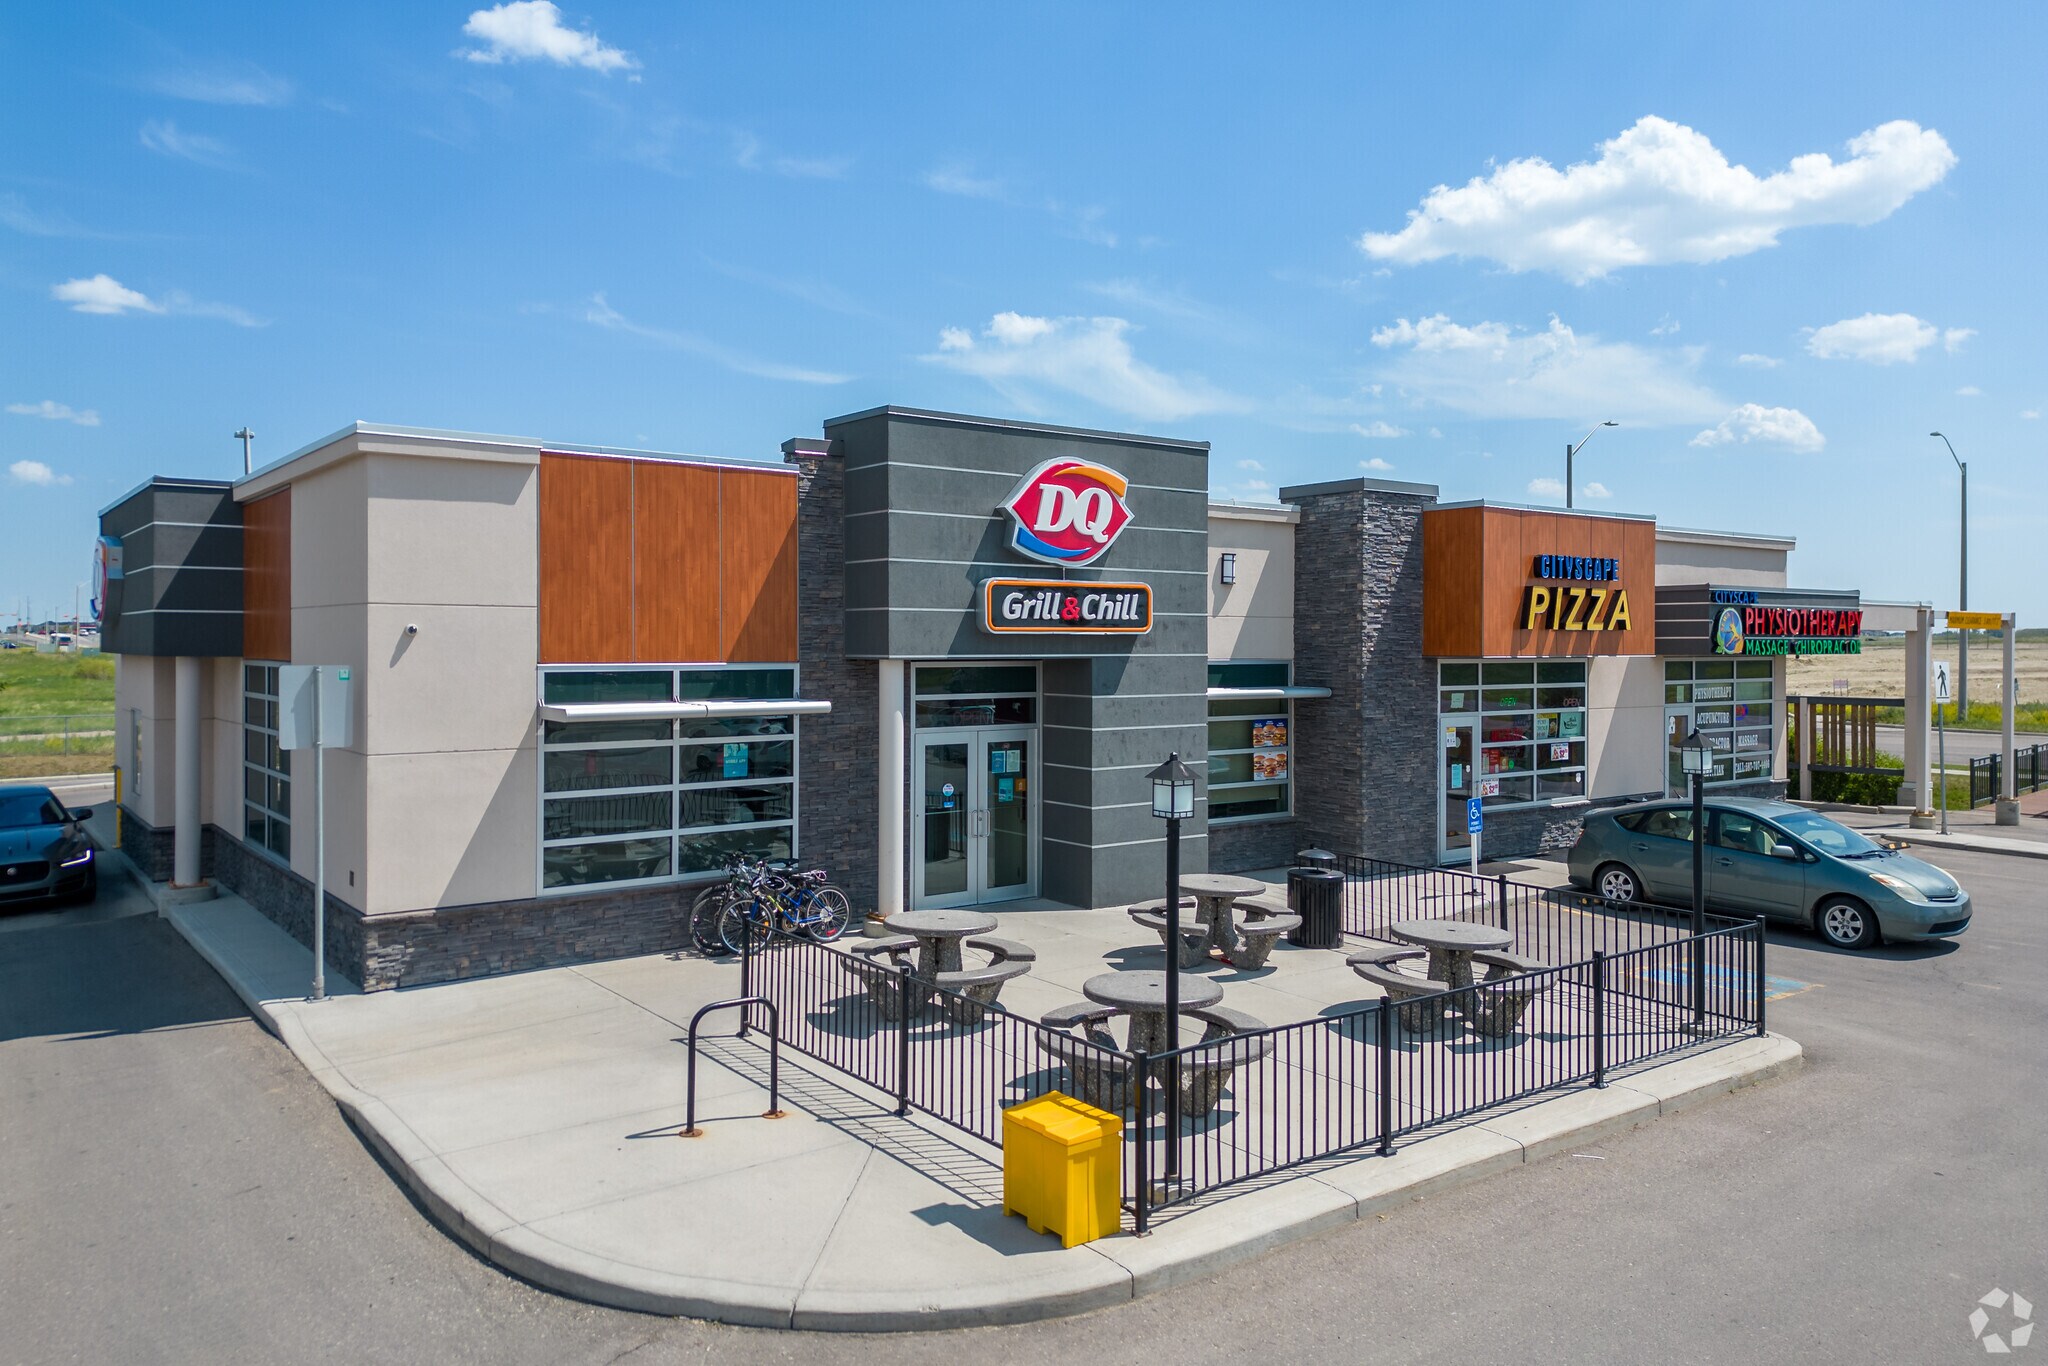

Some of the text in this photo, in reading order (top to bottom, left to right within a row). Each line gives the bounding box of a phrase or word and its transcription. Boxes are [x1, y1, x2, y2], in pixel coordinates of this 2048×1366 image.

[1033, 483, 1113, 543] DQ
[1541, 554, 1619, 581] CITYSCAPE
[1527, 585, 1632, 631] PIZZA
[1745, 607, 1864, 636] PHYSIOTHERAPY
[1745, 638, 1789, 655] MASSAGE
[1694, 686, 1732, 700] PHYSIOTHERAPY
[1500, 697, 1517, 707] OPEN
[1563, 697, 1581, 707] OPEN
[1697, 711, 1730, 725] ACUPUNCTURE
[1738, 734, 1759, 747] MASSAGE
